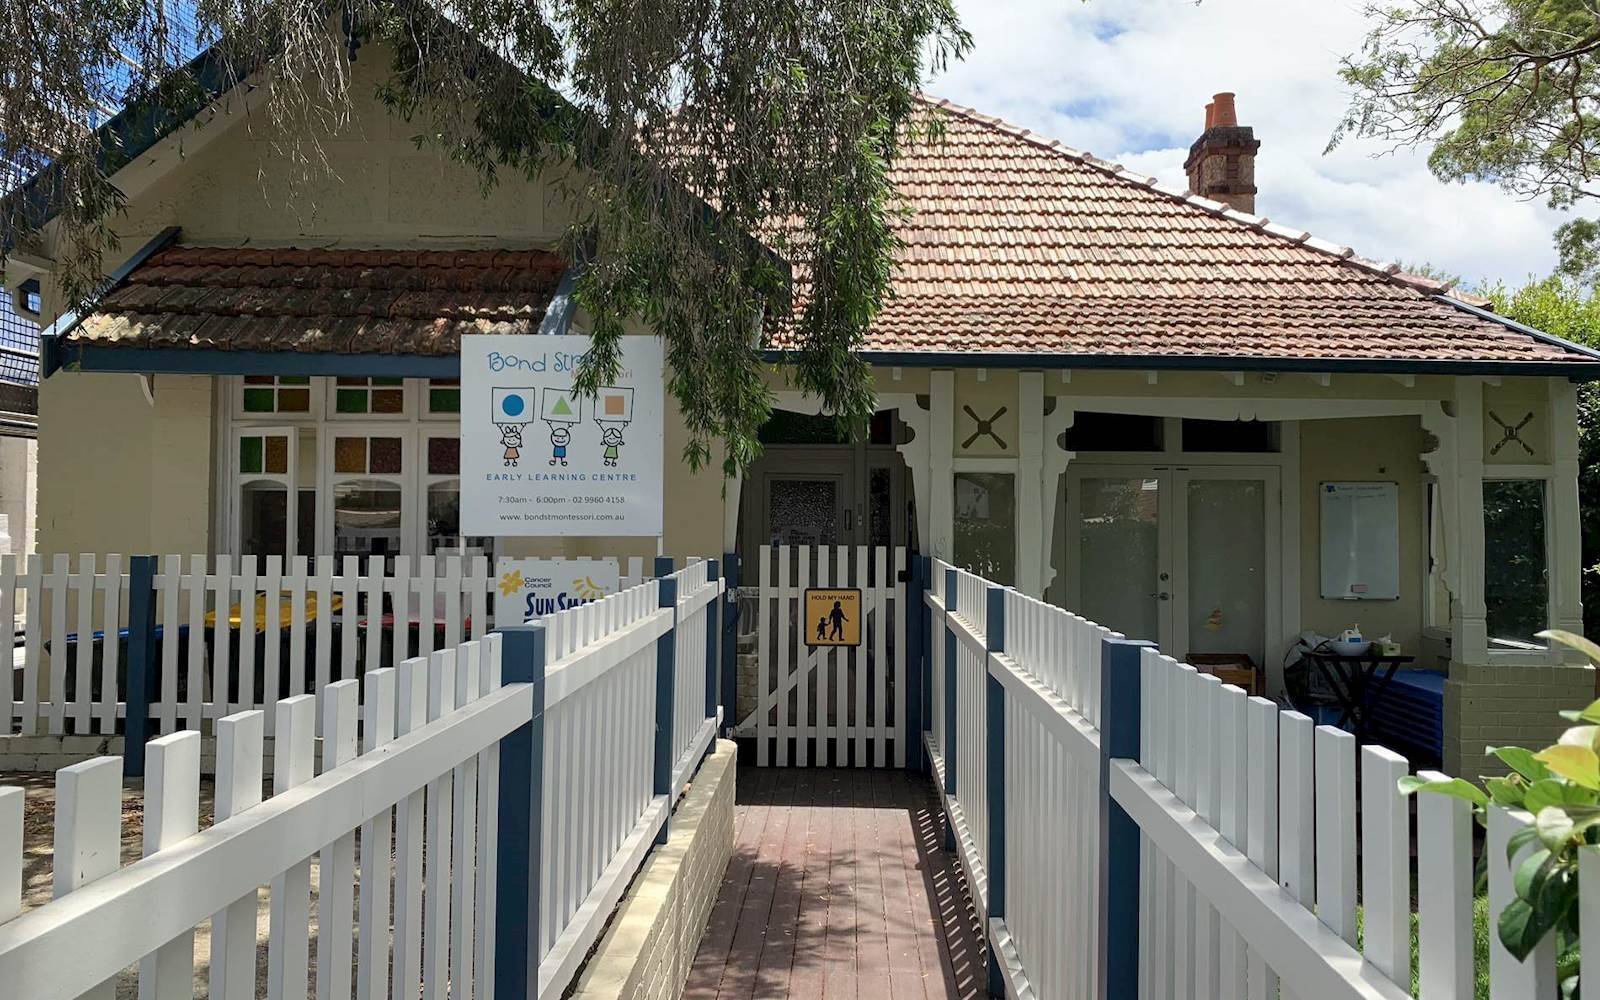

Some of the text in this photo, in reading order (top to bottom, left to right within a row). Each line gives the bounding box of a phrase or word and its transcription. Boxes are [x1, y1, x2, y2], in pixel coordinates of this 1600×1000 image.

[487, 352, 546, 372] Bond
[486, 473, 637, 481] EARLY LEARNING CENTRE
[498, 496, 527, 504] 7:30am
[536, 496, 565, 505] 6:00pm
[573, 496, 583, 504] 02
[584, 496, 604, 504] 9960
[605, 496, 625, 504] 4158
